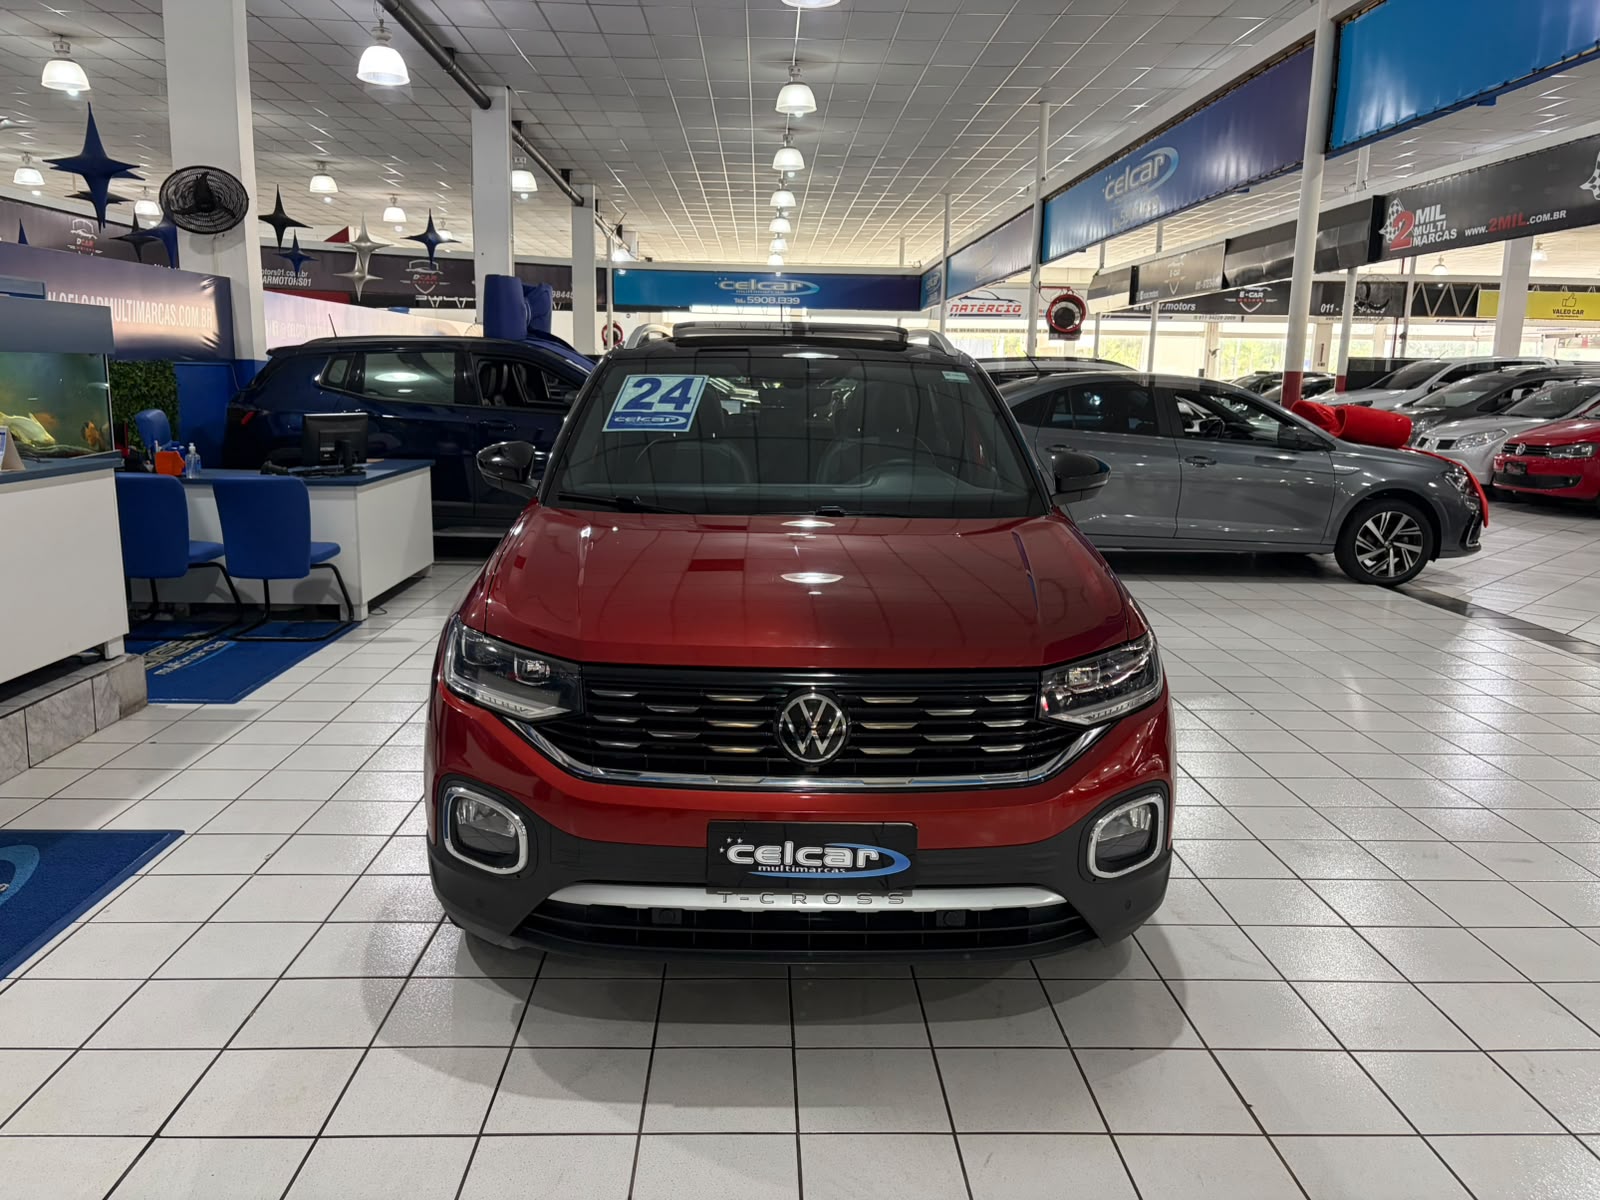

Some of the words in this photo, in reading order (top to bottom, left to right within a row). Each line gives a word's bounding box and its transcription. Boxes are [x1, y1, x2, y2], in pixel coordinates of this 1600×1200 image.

[1105, 154, 1166, 201] celcar
[1391, 210, 1415, 251] 2
[1415, 203, 1447, 226] MIL
[1413, 220, 1447, 236] MULTI
[1412, 228, 1458, 248] MARCAS
[718, 278, 803, 291] celcar
[1145, 302, 1197, 312] er.motors
[622, 377, 695, 411] 24
[726, 840, 880, 869] celcar
[758, 863, 847, 874] multimarcas
[716, 891, 905, 905] T-CROSS
